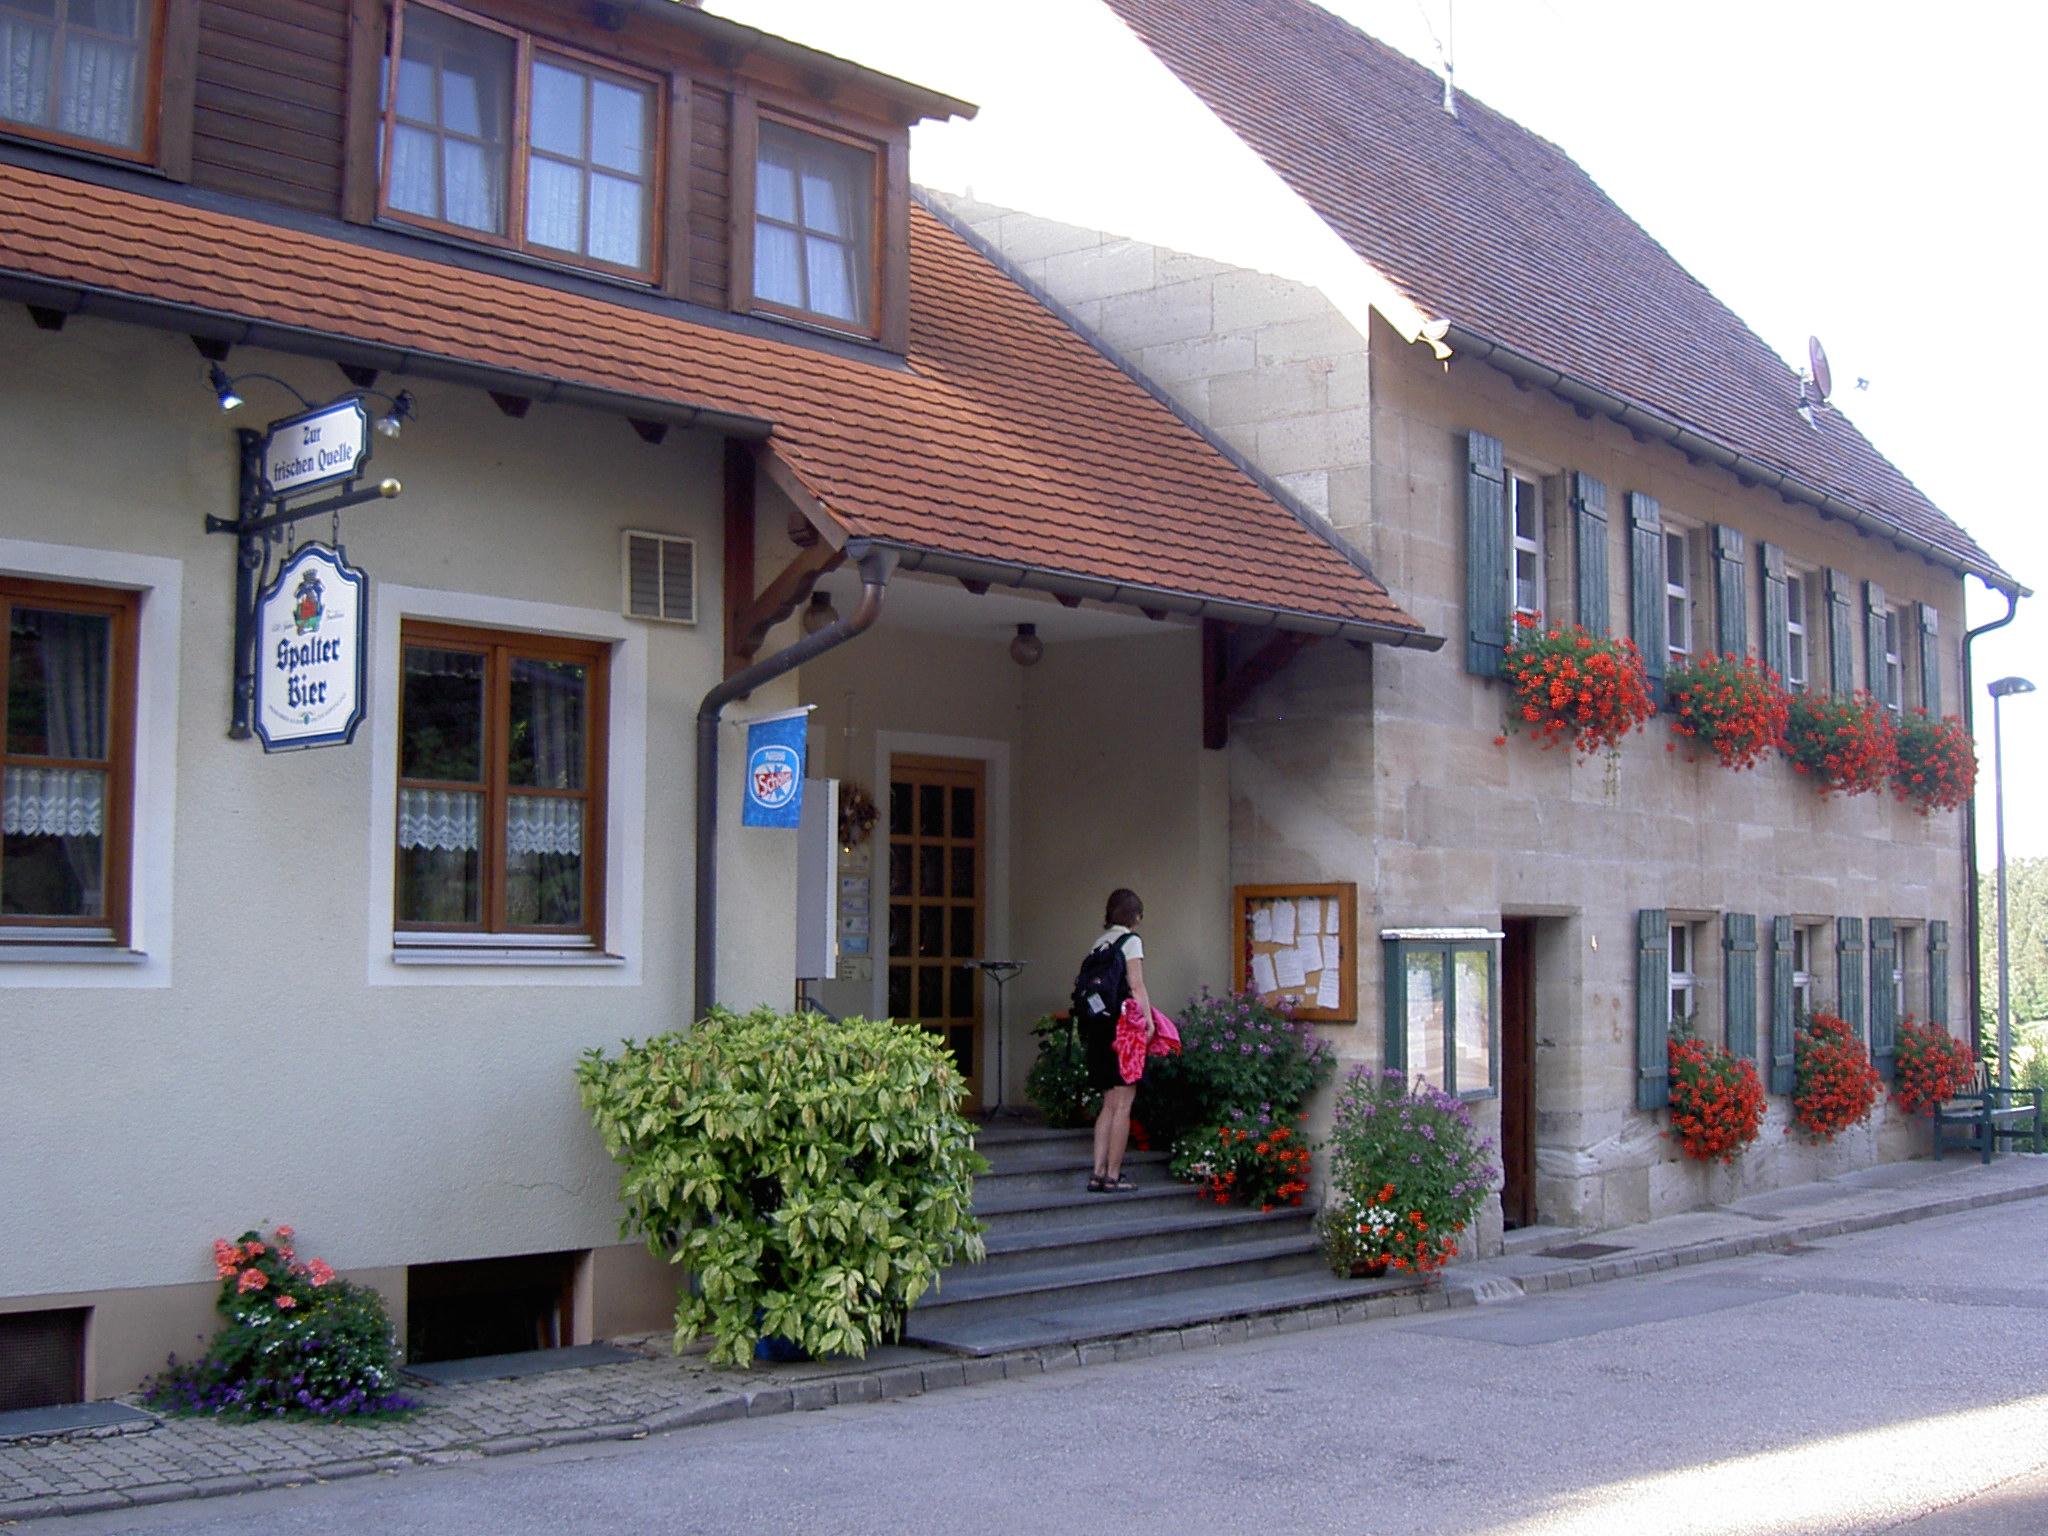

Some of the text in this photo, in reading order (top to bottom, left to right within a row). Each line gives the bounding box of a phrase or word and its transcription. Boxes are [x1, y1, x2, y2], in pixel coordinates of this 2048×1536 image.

[303, 424, 322, 445] Zur
[274, 441, 353, 482] frischen Quelle
[277, 636, 341, 673] Spalter
[288, 674, 327, 709] Bier
